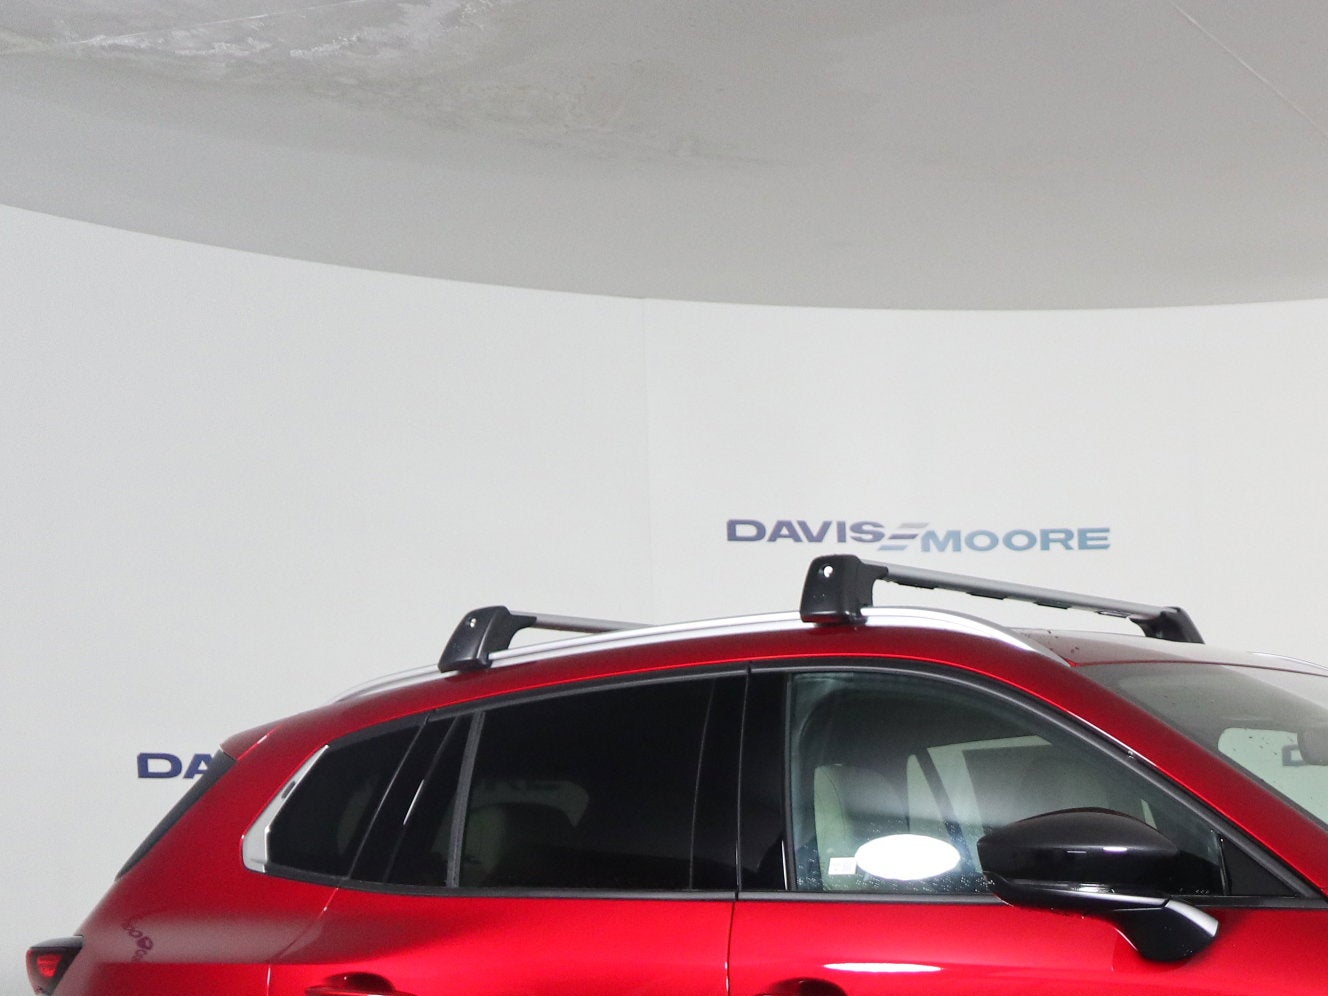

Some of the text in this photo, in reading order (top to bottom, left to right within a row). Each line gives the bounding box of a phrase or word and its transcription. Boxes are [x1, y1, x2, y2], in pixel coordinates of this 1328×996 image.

[725, 519, 1111, 552] DAVIS MOORE
[136, 752, 214, 779] DA
